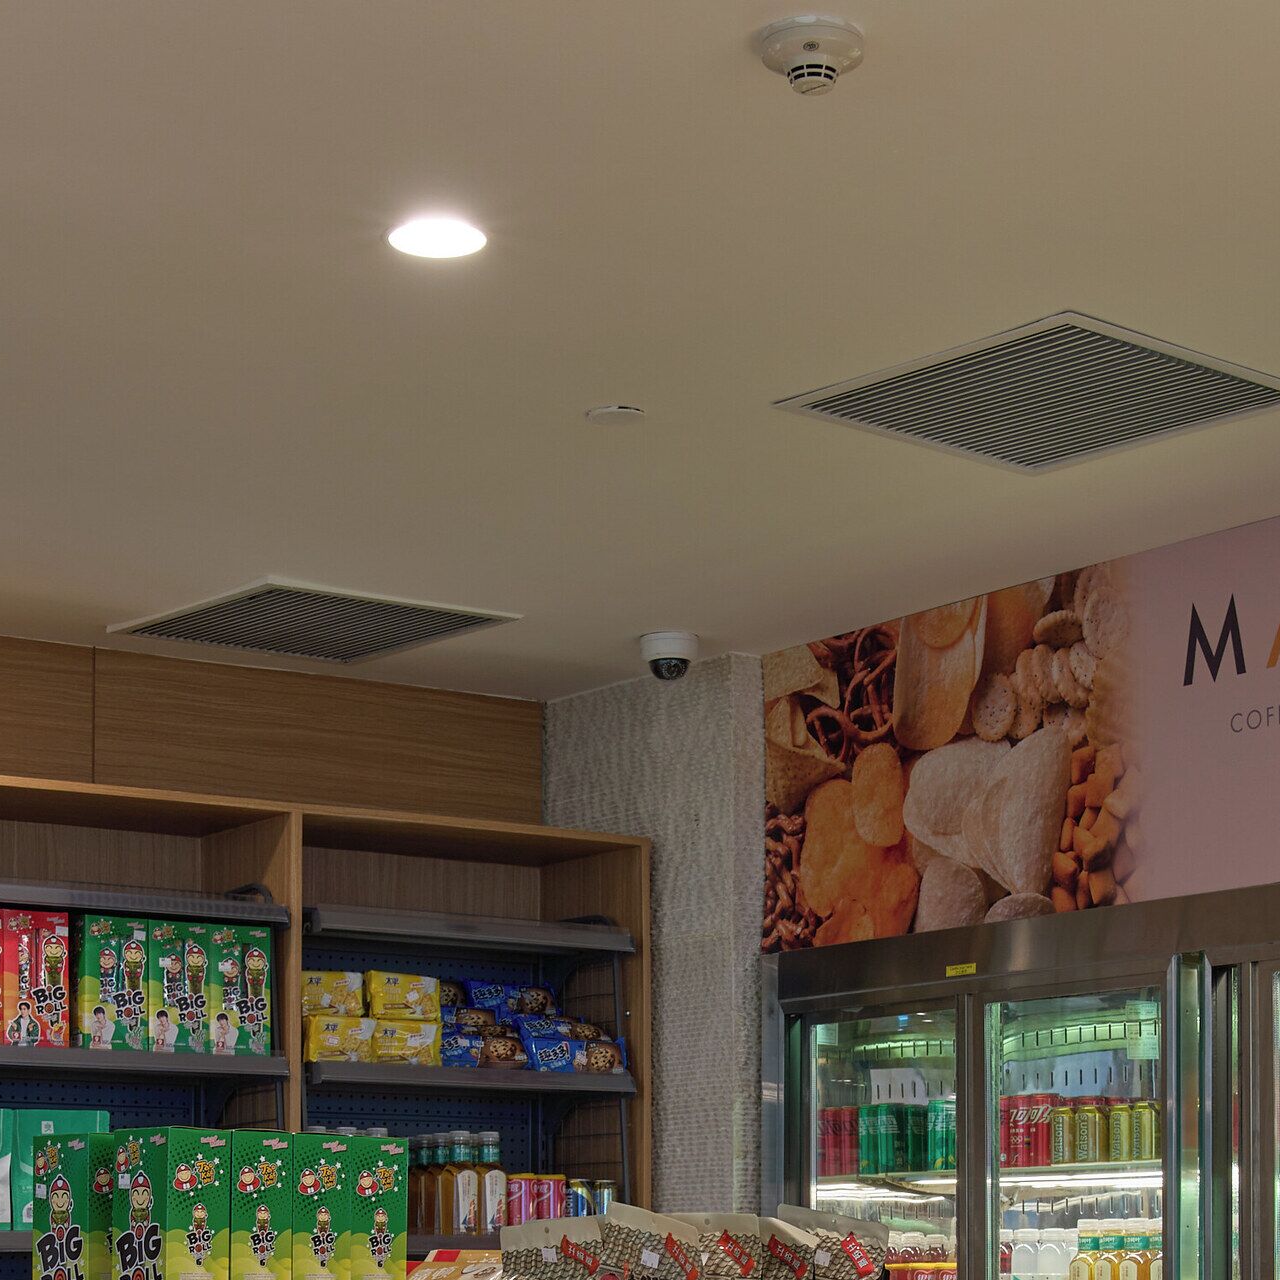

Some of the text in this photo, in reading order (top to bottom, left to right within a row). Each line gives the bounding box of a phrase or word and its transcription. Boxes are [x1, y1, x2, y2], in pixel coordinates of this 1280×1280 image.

[36, 1003, 66, 1015] ROLL
[116, 1007, 146, 1018] ROLL
[179, 1010, 207, 1022] ROLL
[239, 1013, 268, 1025] ROLL
[1054, 1116, 1063, 1162] Watson's
[1077, 1113, 1088, 1160] Watson's
[1112, 1112, 1121, 1159] Watson's
[1132, 1110, 1142, 1158] Watson's
[189, 1243, 211, 1254] ROLL
[253, 1245, 275, 1255] ROLL
[314, 1246, 335, 1256] ROLL
[371, 1247, 392, 1256] ROLL
